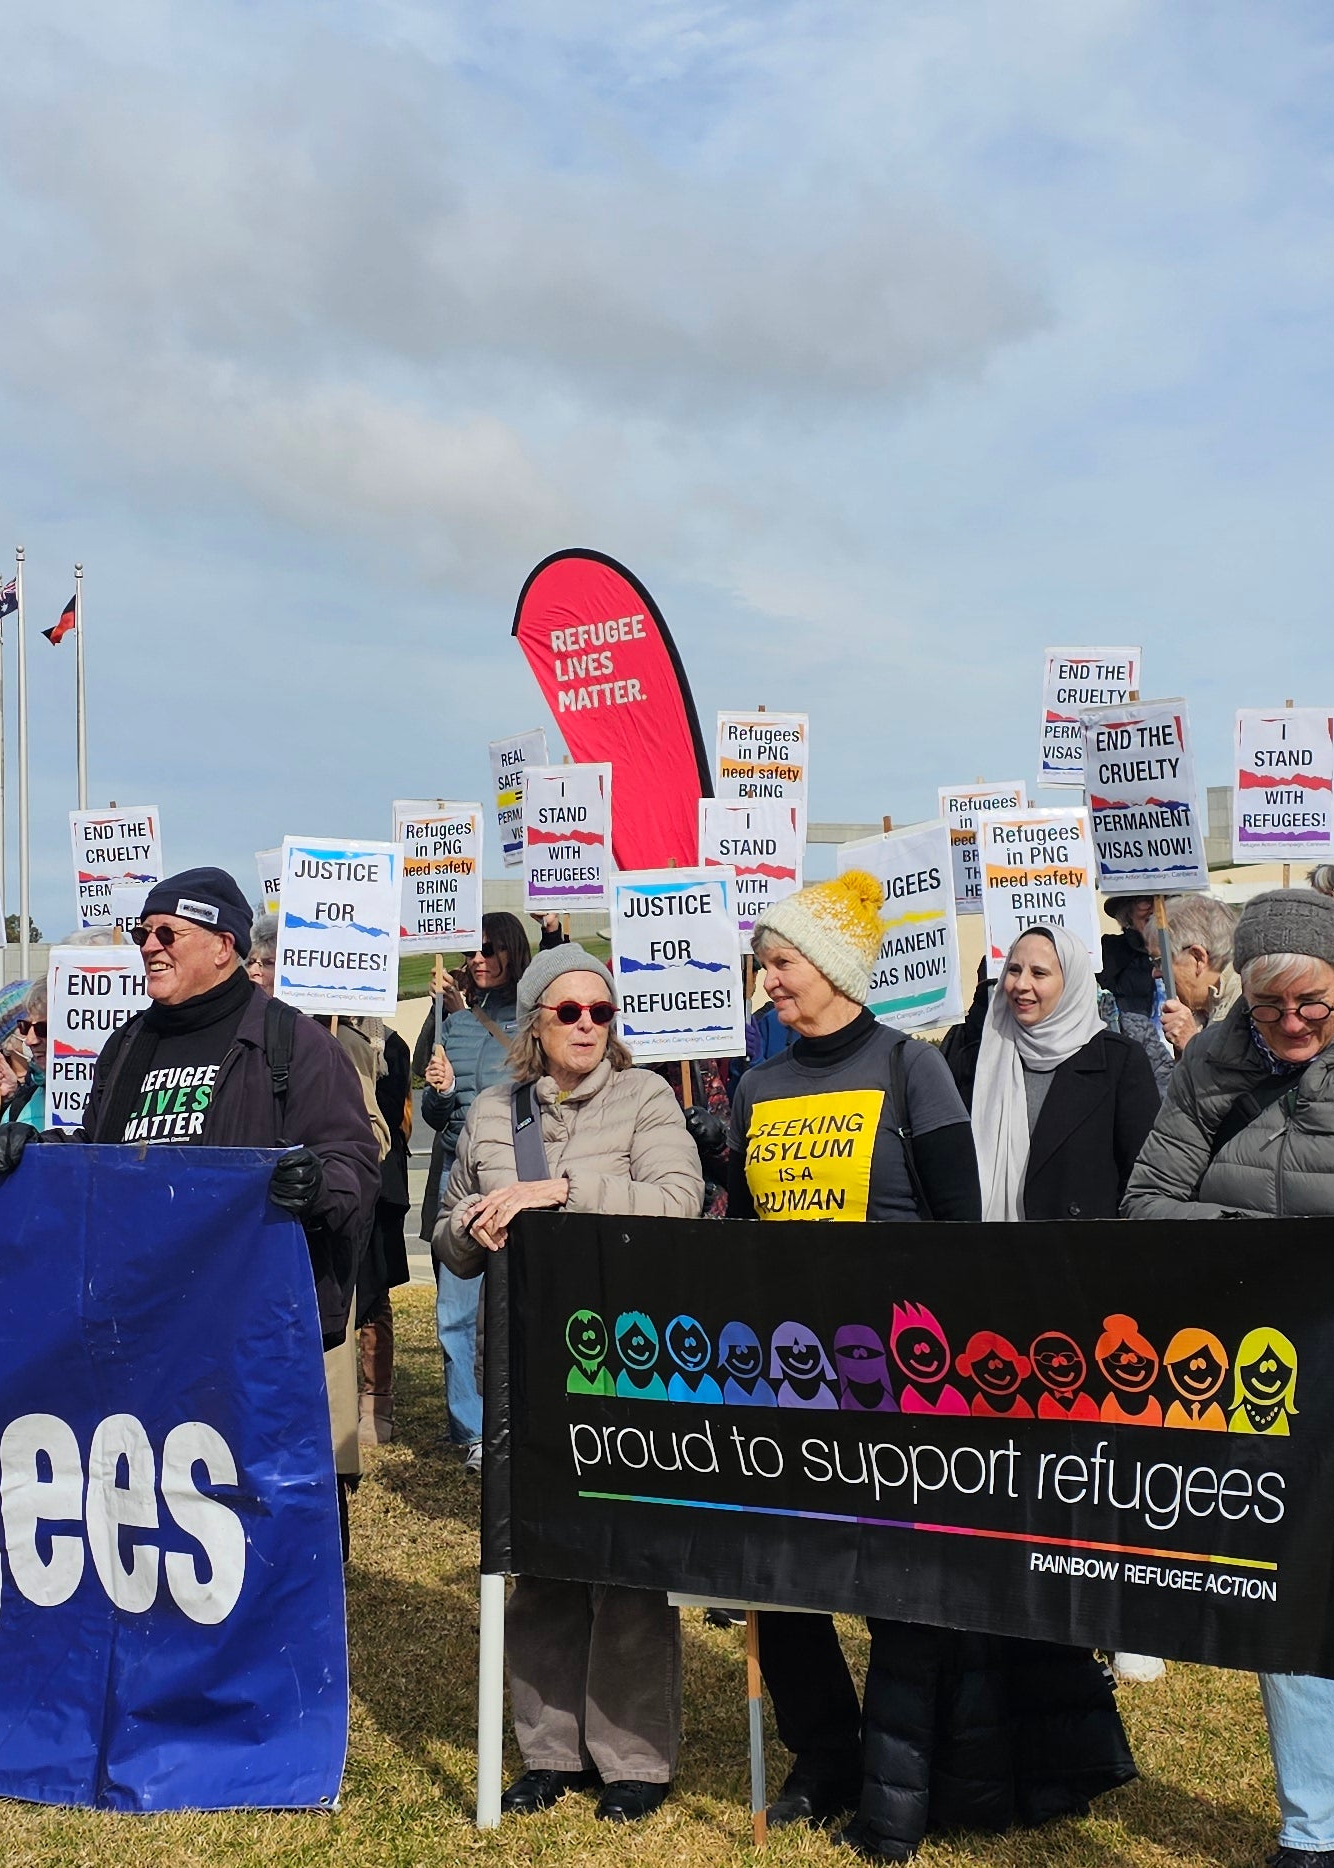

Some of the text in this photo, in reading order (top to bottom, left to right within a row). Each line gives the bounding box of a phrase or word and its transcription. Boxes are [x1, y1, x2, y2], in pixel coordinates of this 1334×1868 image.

[551, 614, 646, 654] REFUGEE
[555, 651, 613, 683] LIVES
[1058, 664, 1126, 681] END THE
[557, 678, 648, 713] MATTER.
[1056, 688, 1127, 704] CRUELTY
[728, 725, 800, 744] Refugees
[1096, 728, 1132, 753] END
[1136, 725, 1174, 747] THE
[1281, 724, 1286, 740] I
[501, 748, 526, 767] REAL
[738, 744, 789, 761] in PNG
[1043, 746, 1083, 760] VISAS
[1254, 749, 1313, 767] STAND
[498, 770, 523, 790] SAFE
[722, 766, 799, 782] need safety
[1098, 758, 1180, 785] CRUELTY
[560, 782, 565, 798] I
[739, 784, 783, 798] BRING
[1264, 790, 1304, 805] WITH
[949, 796, 1017, 812] Refugees
[539, 806, 587, 824] STAND
[746, 813, 750, 829] I
[959, 815, 972, 828] in
[1093, 808, 1191, 833] PERMANENT
[1242, 812, 1326, 828] REFUGEES!
[83, 822, 147, 841] END THE
[406, 822, 471, 840] Refugees
[992, 825, 1080, 845] Refugees
[85, 844, 151, 865] CRUELTY
[415, 838, 462, 857] in PNG
[548, 846, 581, 861] WITH
[719, 839, 777, 856] STAND
[1007, 846, 1068, 865] in PNG
[1097, 837, 1192, 860] VISAS NOW!
[293, 860, 379, 883] JUSTICE
[434, 860, 472, 875] safety
[531, 867, 601, 883] REFUGEES!
[416, 879, 458, 894] BRING
[989, 870, 1083, 889] need safety
[81, 903, 111, 917] VISA
[418, 898, 455, 914] THEM
[623, 894, 712, 919] JUSTICE
[1011, 891, 1066, 910] BRING
[315, 902, 355, 922] FOR
[418, 918, 456, 933] HERE!
[650, 940, 692, 961] FOR
[877, 927, 947, 960] MANENT
[282, 949, 387, 972] REFUGEES!
[869, 956, 946, 990] SAS NOW!
[67, 974, 146, 996] END TH
[622, 990, 732, 1013] REFUGEES!
[130, 1086, 212, 1119] IVES
[756, 1112, 865, 1138] SEEKING
[748, 1138, 854, 1166] ASYLUM
[779, 1167, 814, 1183] IS A
[756, 1188, 846, 1214] HUMAN
[569, 1420, 1286, 1531] proud to support refugees
[1030, 1552, 1277, 1602] RAINBOW REFUGEE ACTION
